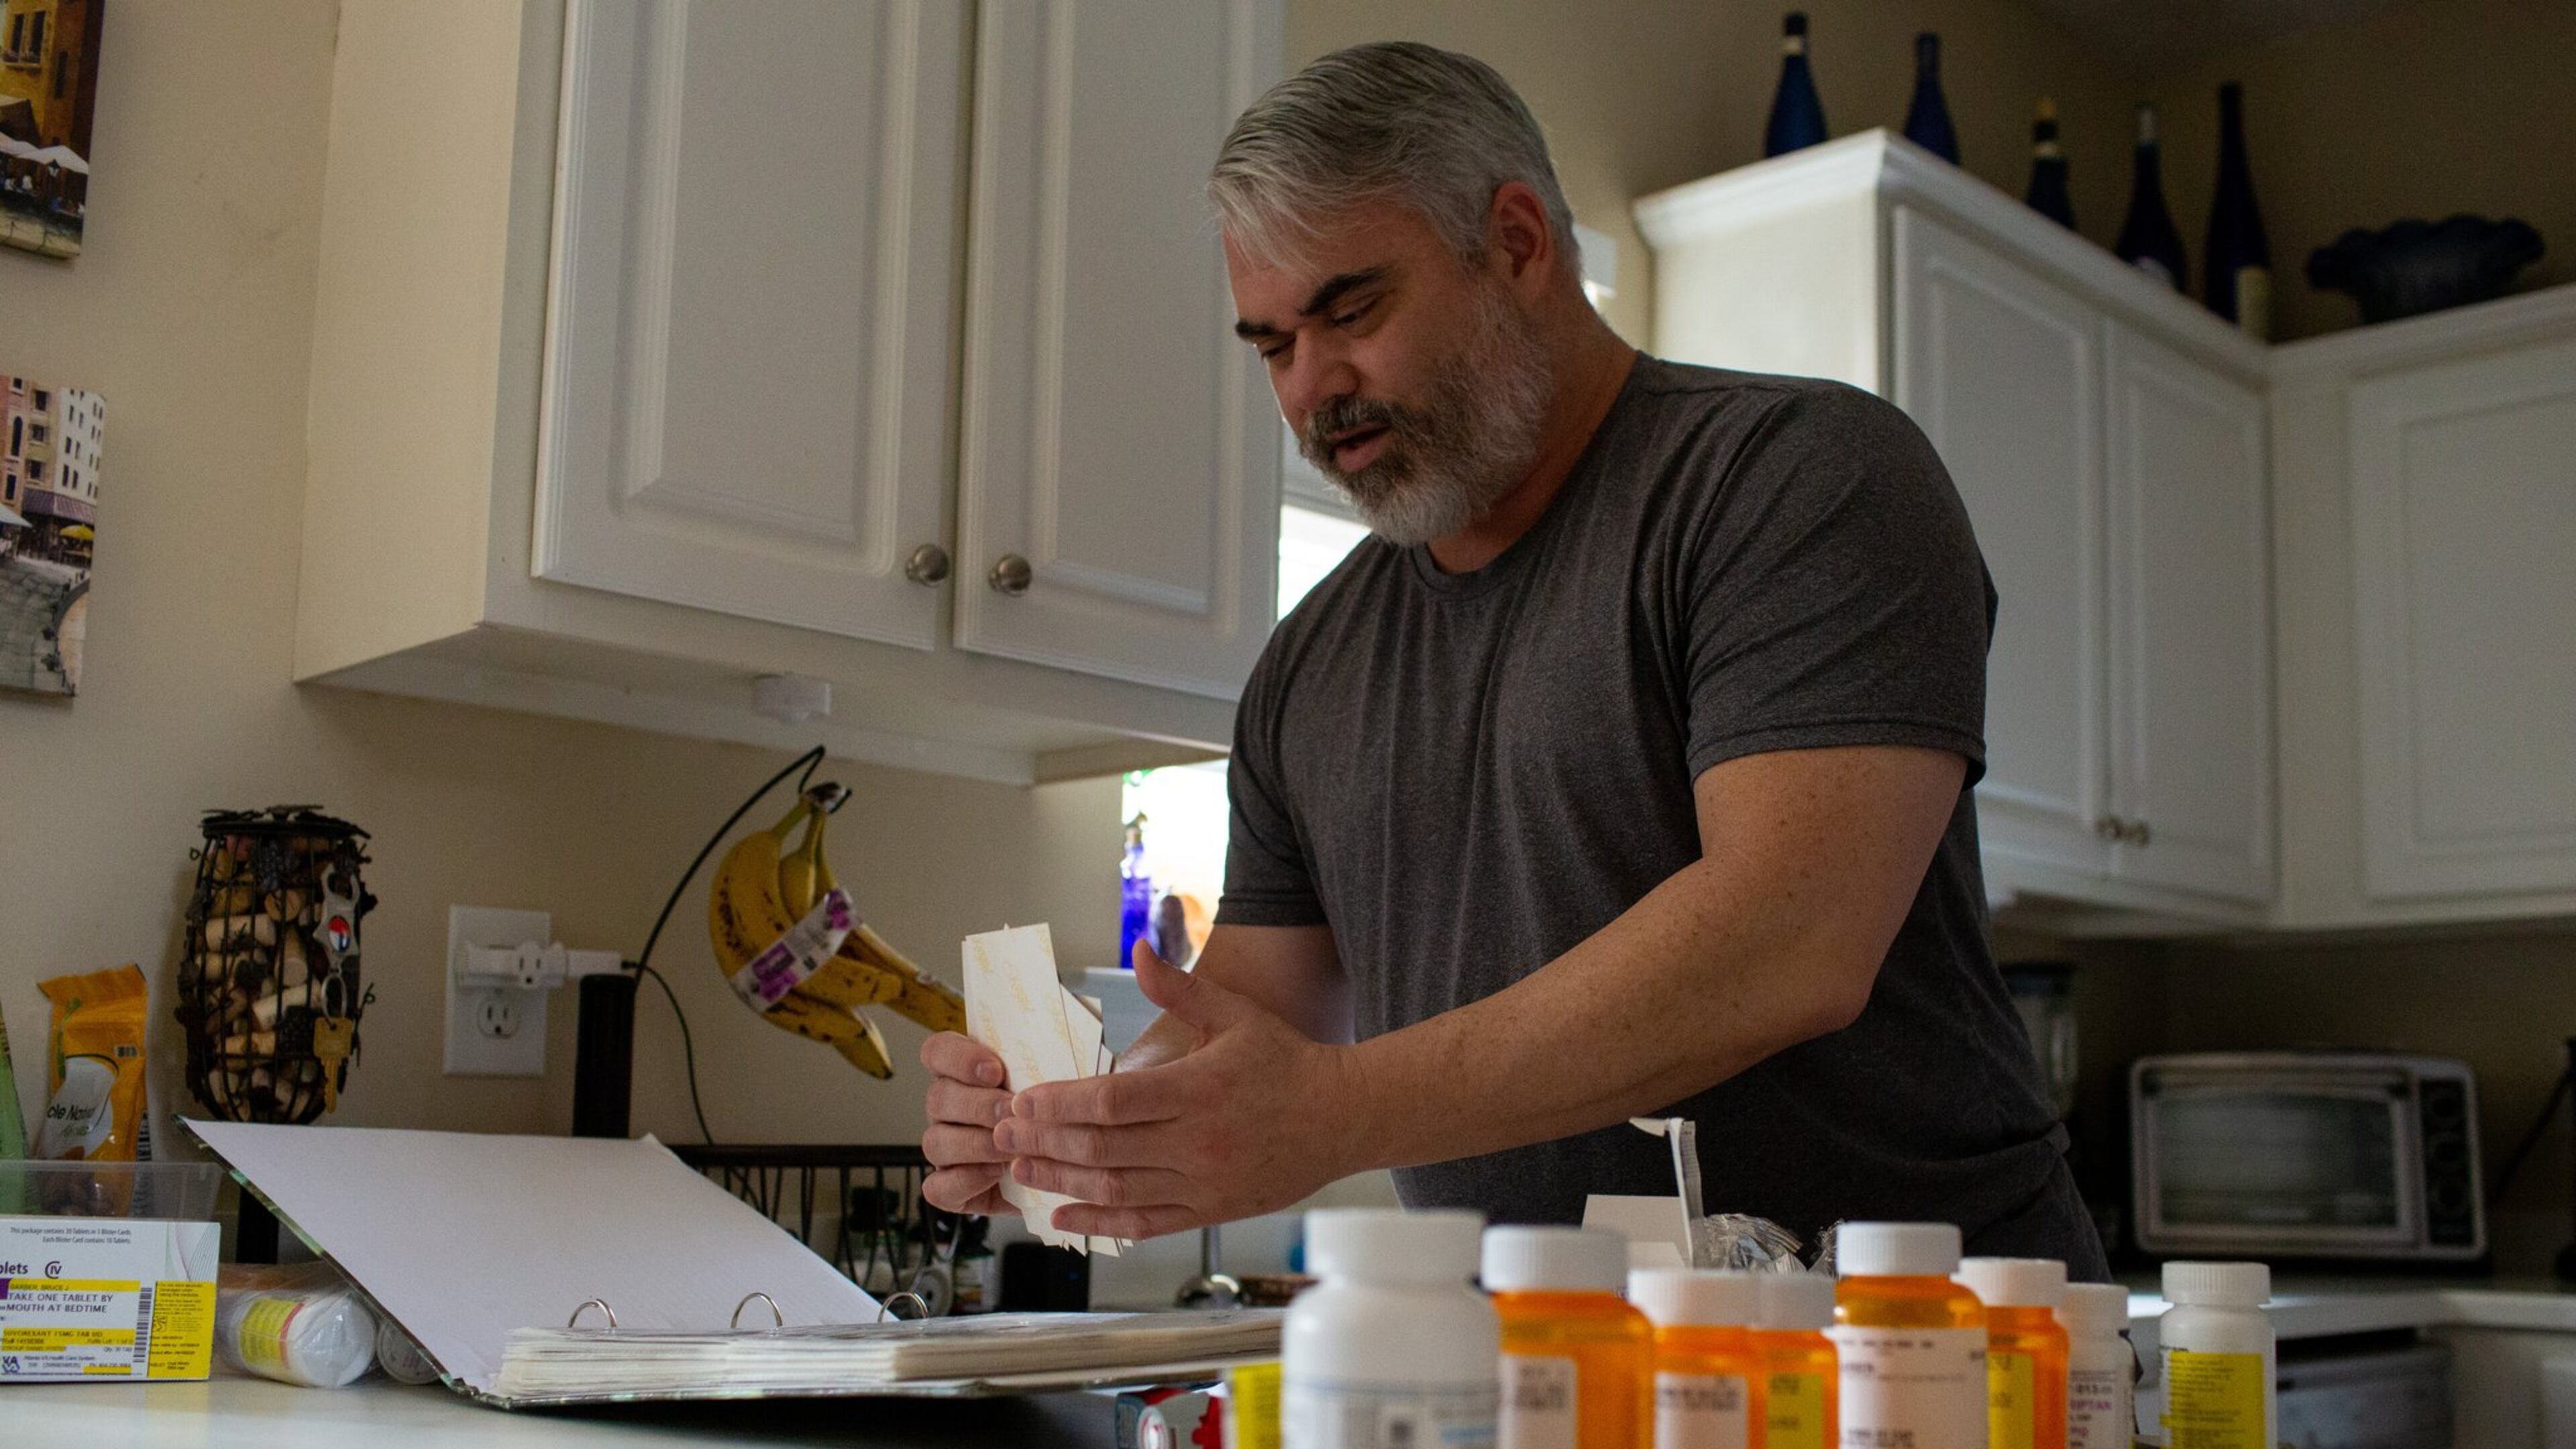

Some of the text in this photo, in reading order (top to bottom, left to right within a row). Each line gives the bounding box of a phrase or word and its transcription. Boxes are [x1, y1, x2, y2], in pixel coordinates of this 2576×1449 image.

[21, 1228, 42, 1236] package
[9, 1293, 113, 1303] TAKE ONE TABLET BY
[6, 1304, 44, 1312] MOUTH
[64, 1305, 107, 1313] BEDTIME
